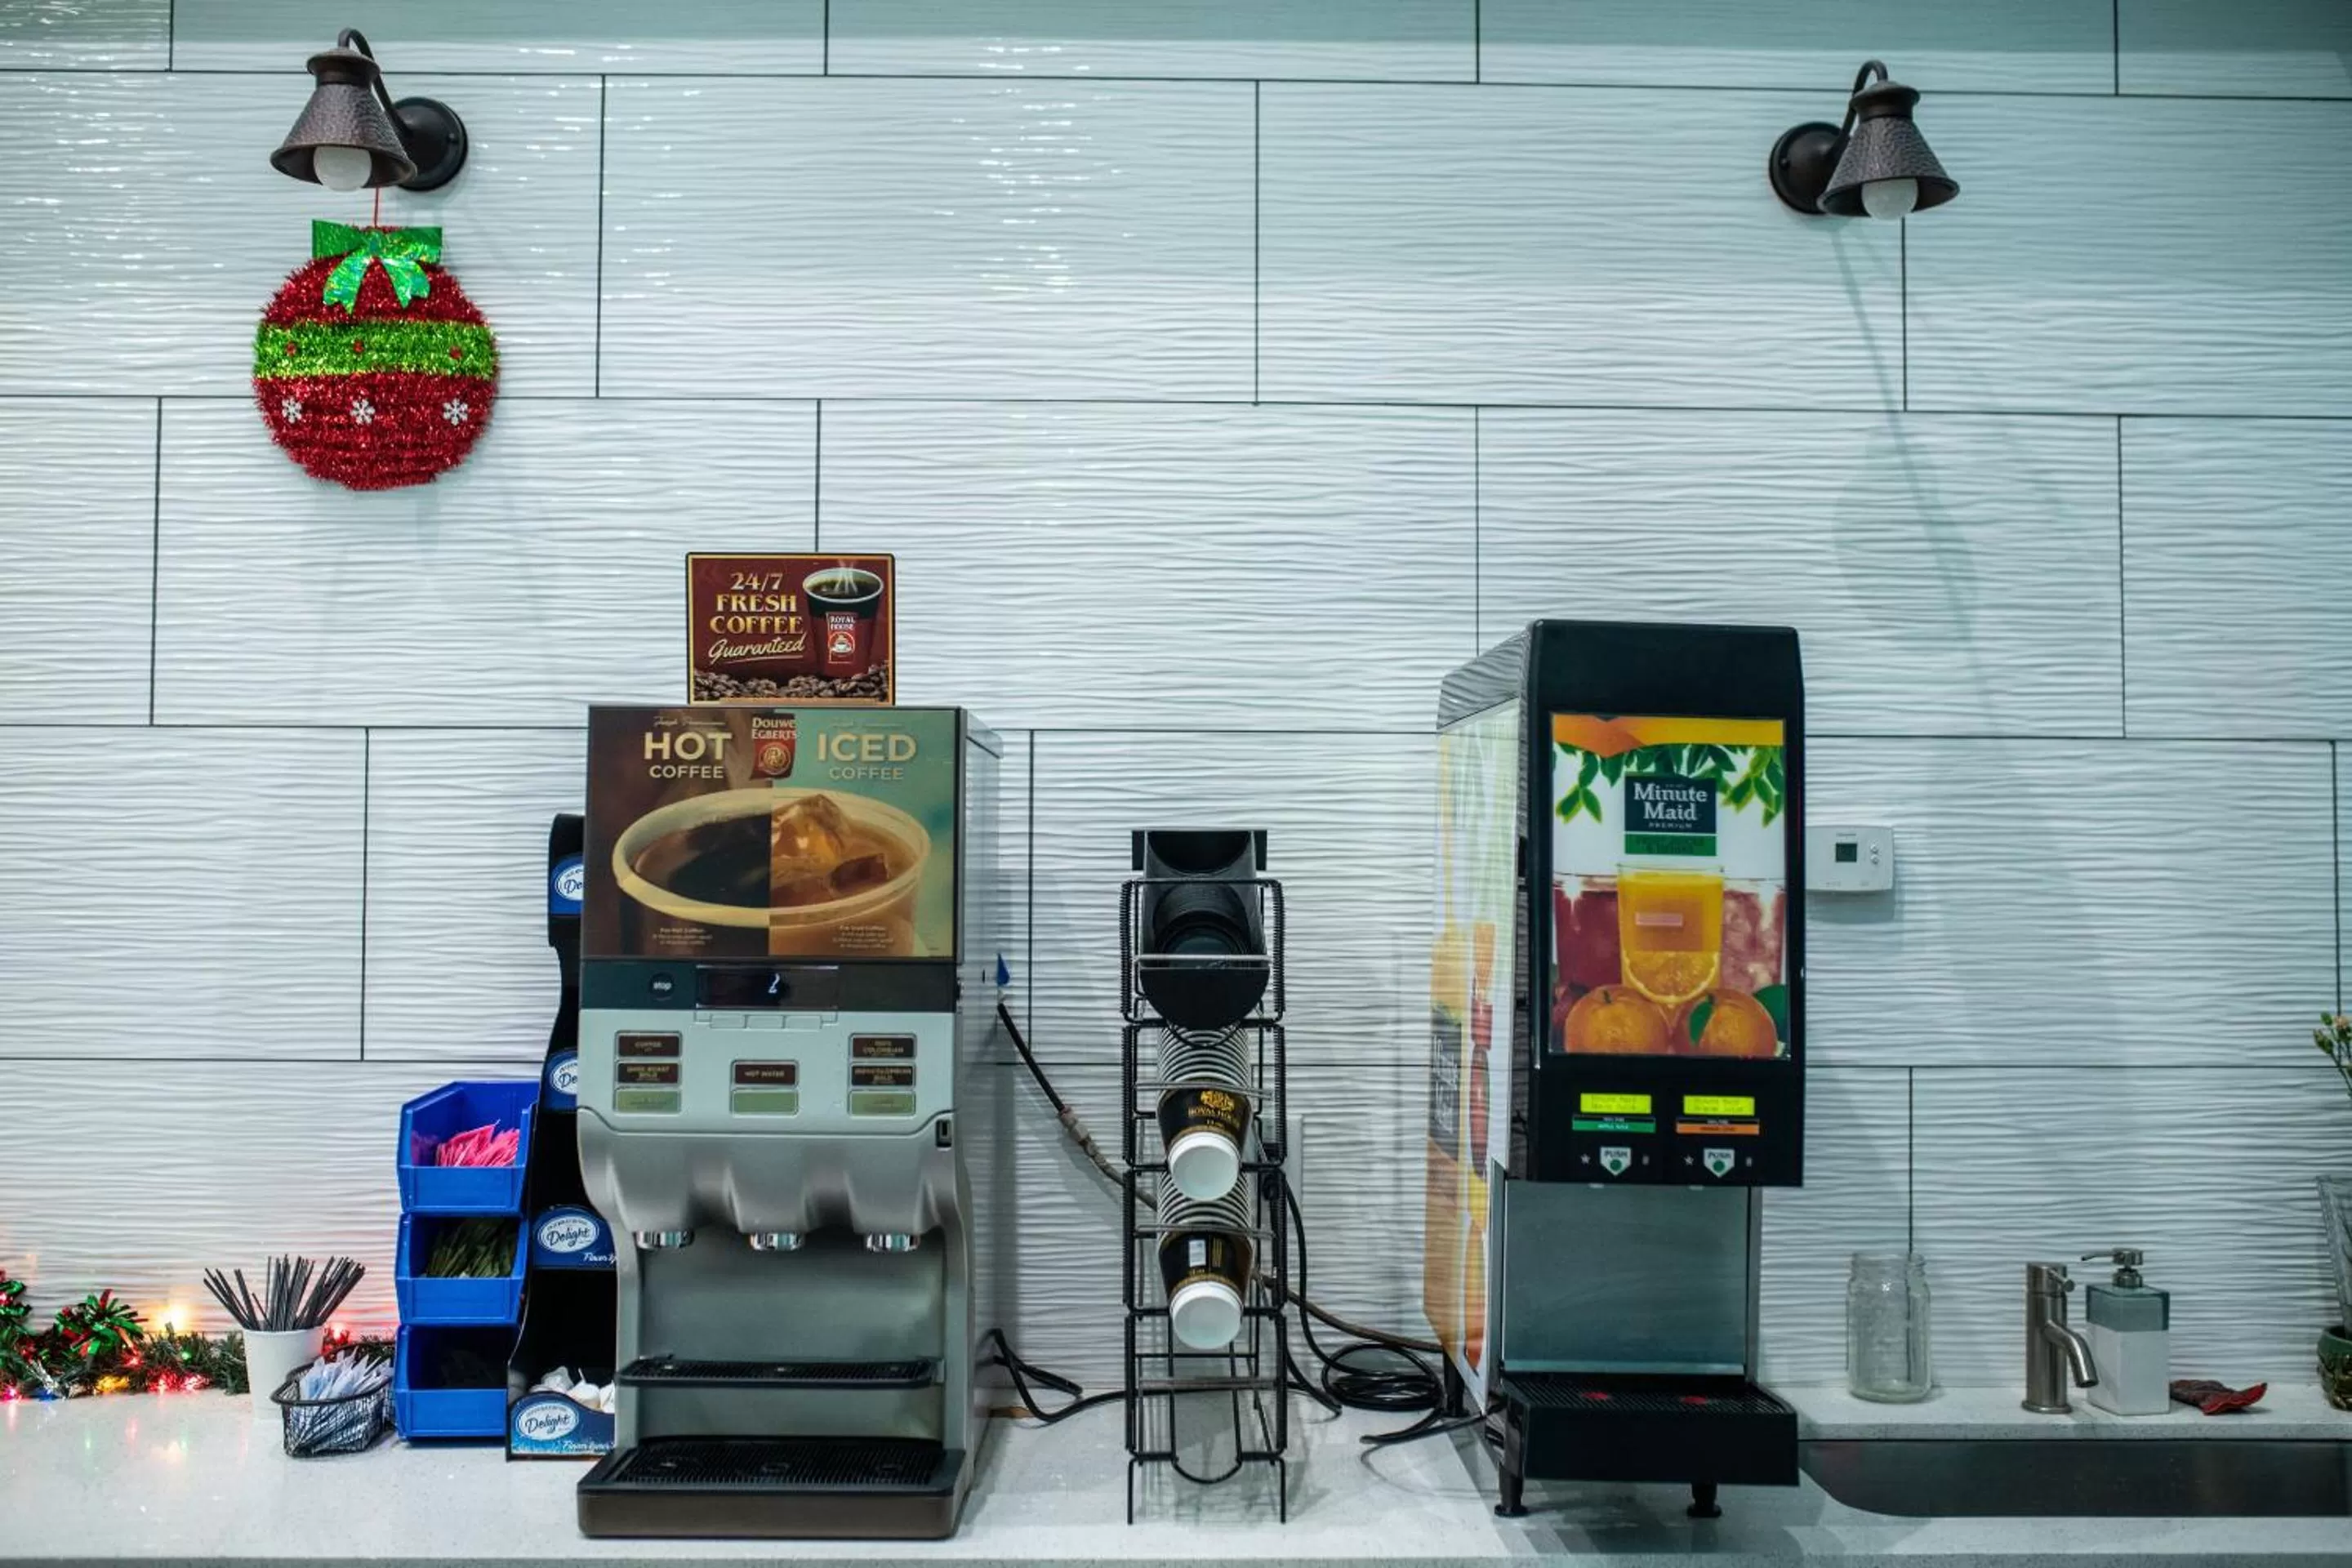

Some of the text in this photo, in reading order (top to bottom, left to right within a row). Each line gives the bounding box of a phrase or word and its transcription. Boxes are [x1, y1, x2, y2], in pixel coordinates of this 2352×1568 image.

[730, 572, 784, 592] 24/7
[716, 594, 797, 612] FRESH
[710, 616, 804, 635] COFFEE
[708, 631, 808, 665] Guaranteed
[644, 732, 733, 760] HOT
[817, 732, 917, 763] ICED
[649, 764, 724, 778] COFFEE
[829, 767, 905, 780] COFFEE
[1633, 782, 1708, 802] Minute
[1642, 801, 1699, 821] Maid
[1603, 1149, 1628, 1159] PUSH
[525, 1414, 570, 1434] Delight
